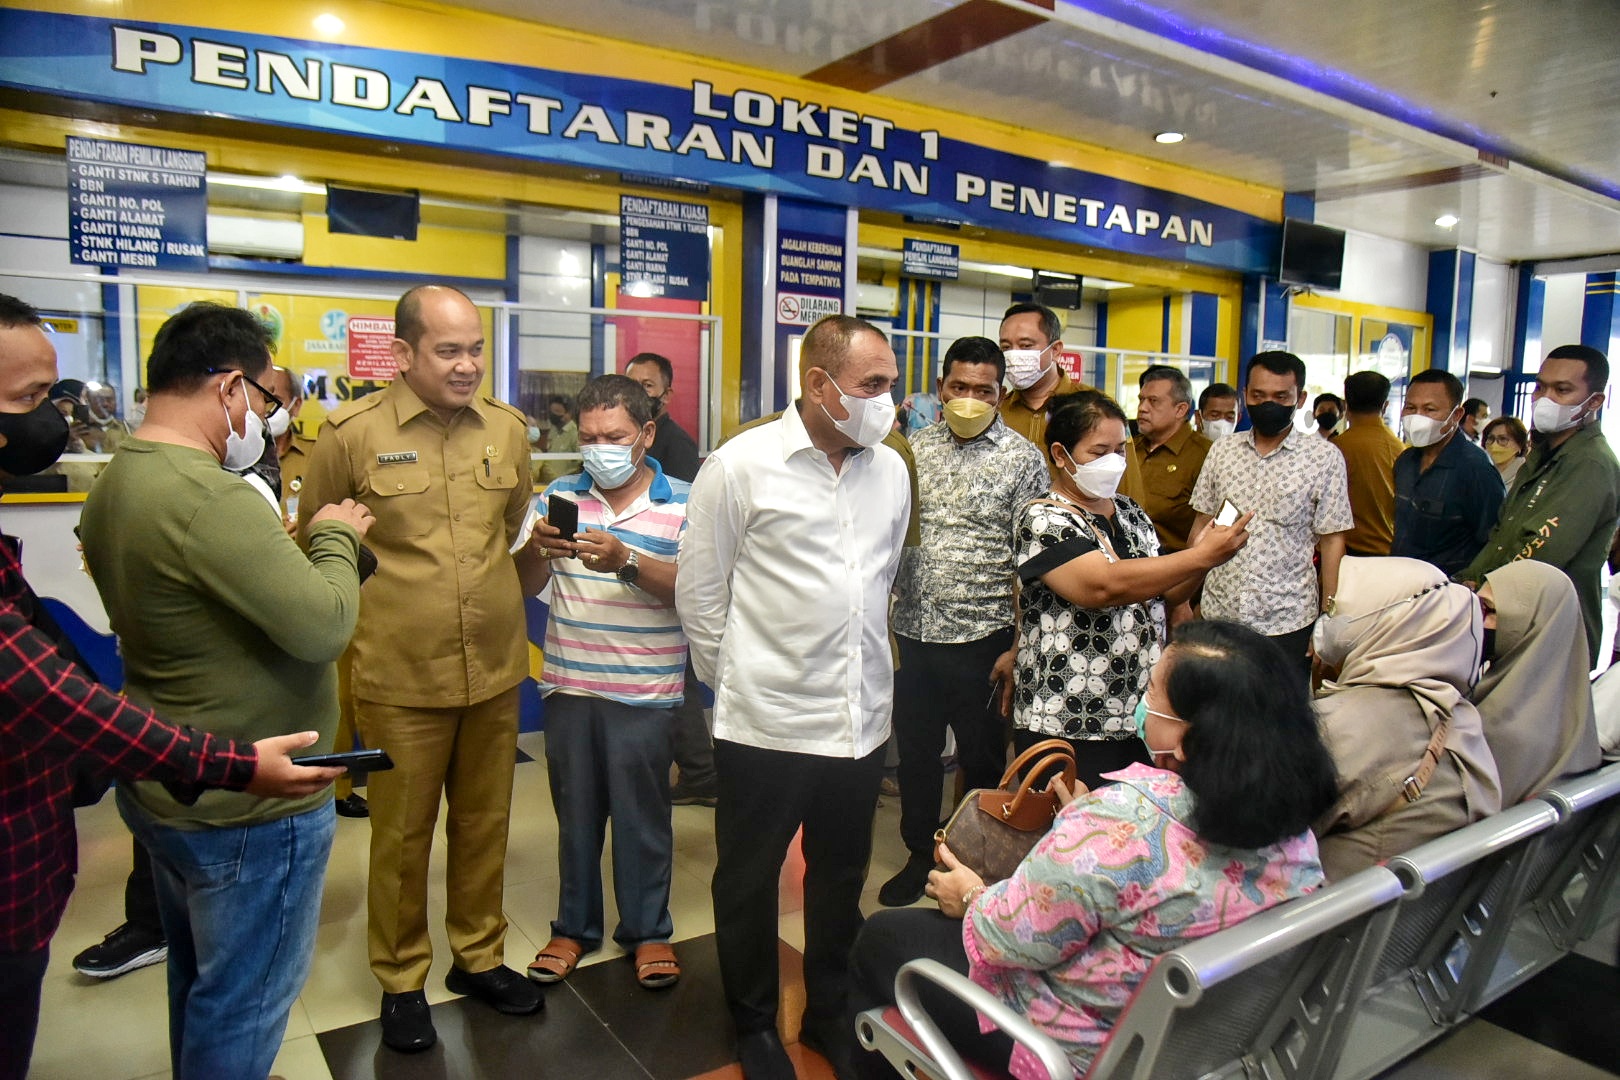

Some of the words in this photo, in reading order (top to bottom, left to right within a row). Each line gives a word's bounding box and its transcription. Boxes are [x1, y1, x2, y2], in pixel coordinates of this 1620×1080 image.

[692, 80, 893, 151] LOKET
[919, 130, 940, 161] 1
[111, 25, 774, 169] PENDAFTARAN
[806, 143, 929, 197] DAN
[955, 171, 1213, 248] PENETAPAN
[69, 138, 128, 162] PENDAFTARAN
[129, 146, 161, 167] PEMILIK
[162, 150, 205, 172] LANGSUNG
[79, 164, 115, 179] GANTI
[119, 169, 150, 184] STNK
[151, 173, 159, 185] 5
[161, 174, 200, 188] TAHUN
[79, 178, 104, 192] BBN
[80, 193, 116, 208] GANTI
[119, 197, 139, 210] NO.
[141, 198, 164, 213] POL
[621, 196, 680, 218] PENDAFTARAN
[681, 203, 707, 221] KUASA
[80, 207, 117, 222] GANTI
[119, 211, 165, 226] ALAMAT
[80, 221, 117, 236] GANTI
[119, 225, 161, 240] WARNA
[81, 235, 114, 249] STNK
[116, 238, 159, 253] HILANG
[166, 242, 205, 257] RUSAK
[626, 238, 645, 249] GANTI
[781, 237, 807, 252] JAGALAH
[808, 241, 842, 257] KEBERSIHAN
[911, 240, 952, 256] PENDAFTARAN
[81, 250, 118, 264] GANTI
[120, 252, 157, 267] MESIN
[626, 249, 645, 260] GANTI
[645, 251, 669, 263] ALAMAT
[781, 254, 816, 270] BUANGLAH
[816, 258, 842, 273] SAMPAH
[904, 251, 928, 263] PEMILIK
[626, 260, 645, 271] GANTI
[645, 262, 667, 273] WARNA
[781, 271, 799, 284] PADA
[801, 273, 841, 289] TEMPATNYA
[800, 297, 839, 313] DILARANG
[800, 311, 826, 323] MERO
[352, 321, 395, 332] HIMBAU
